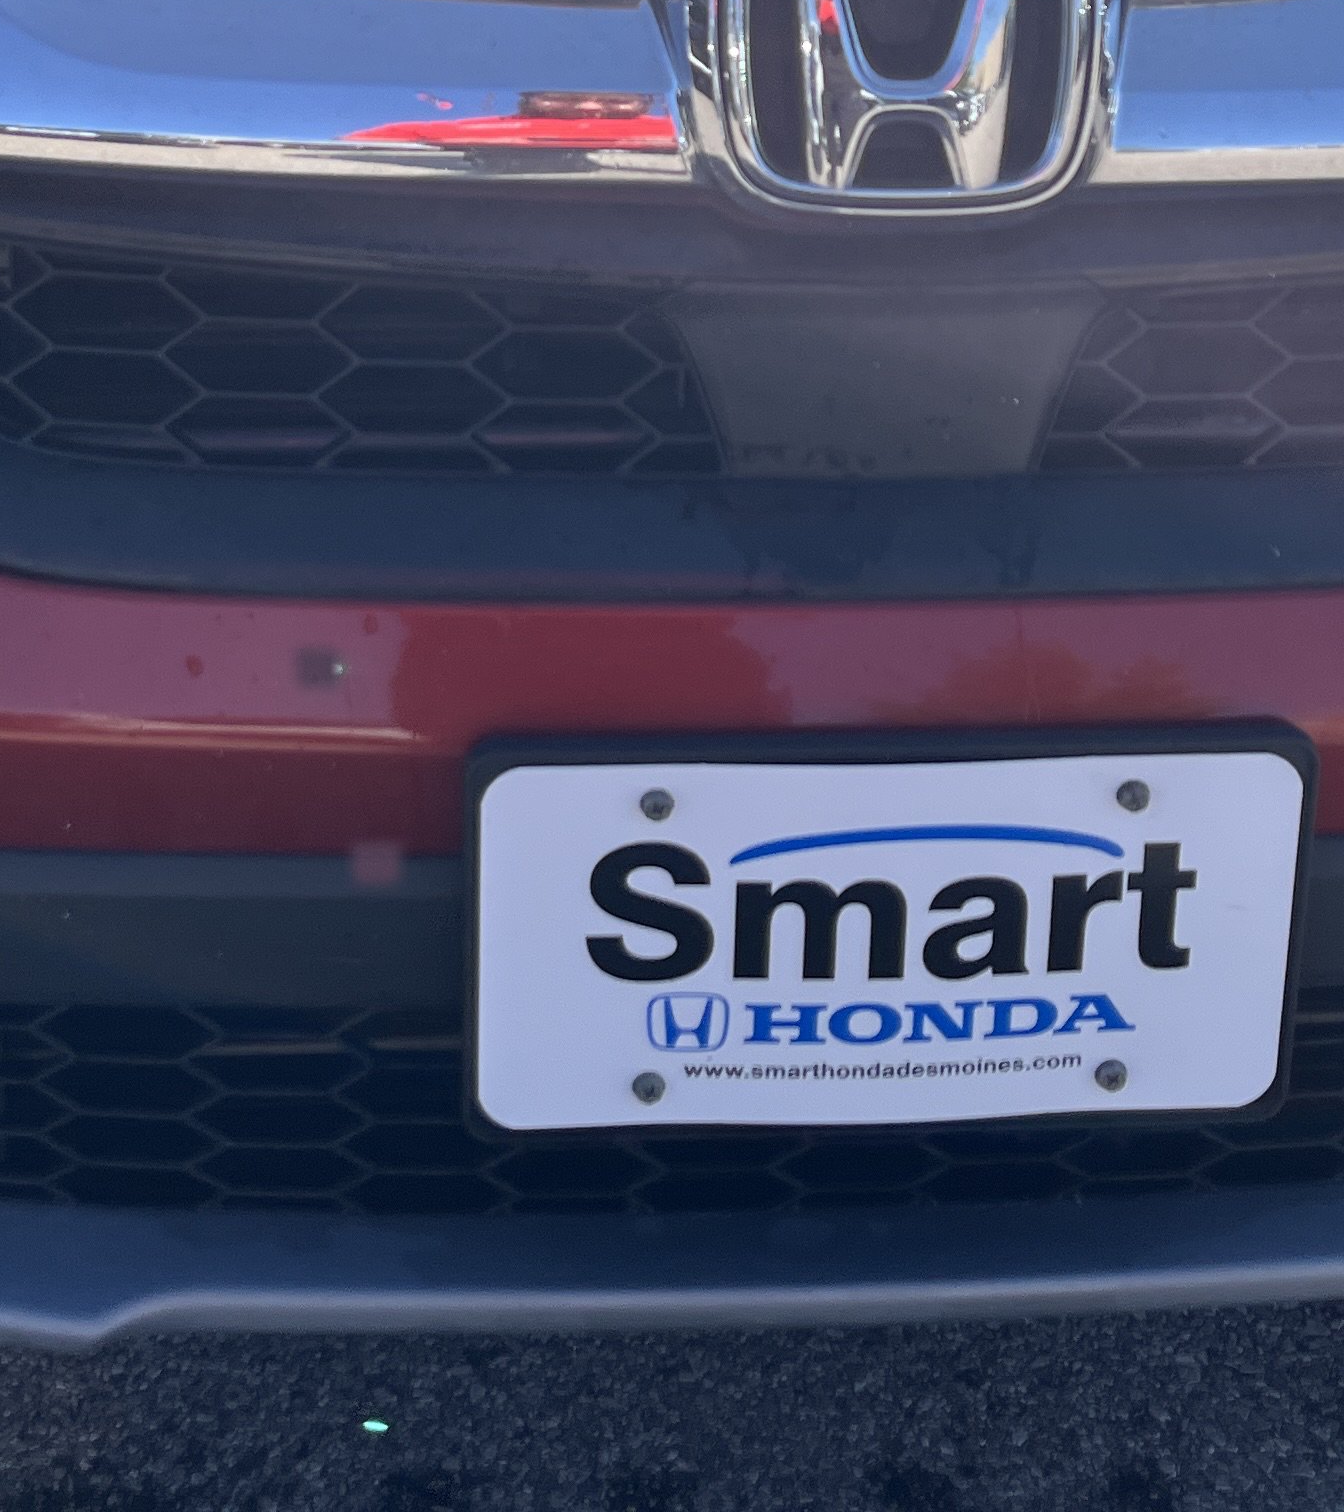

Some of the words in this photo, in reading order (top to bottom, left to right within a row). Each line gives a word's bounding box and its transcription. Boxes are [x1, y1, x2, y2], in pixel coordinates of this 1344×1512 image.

[585, 839, 1198, 982] Smart
[744, 993, 1136, 1046] HONDA
[683, 1053, 1083, 1082] www.smarthondadesmoines.com
